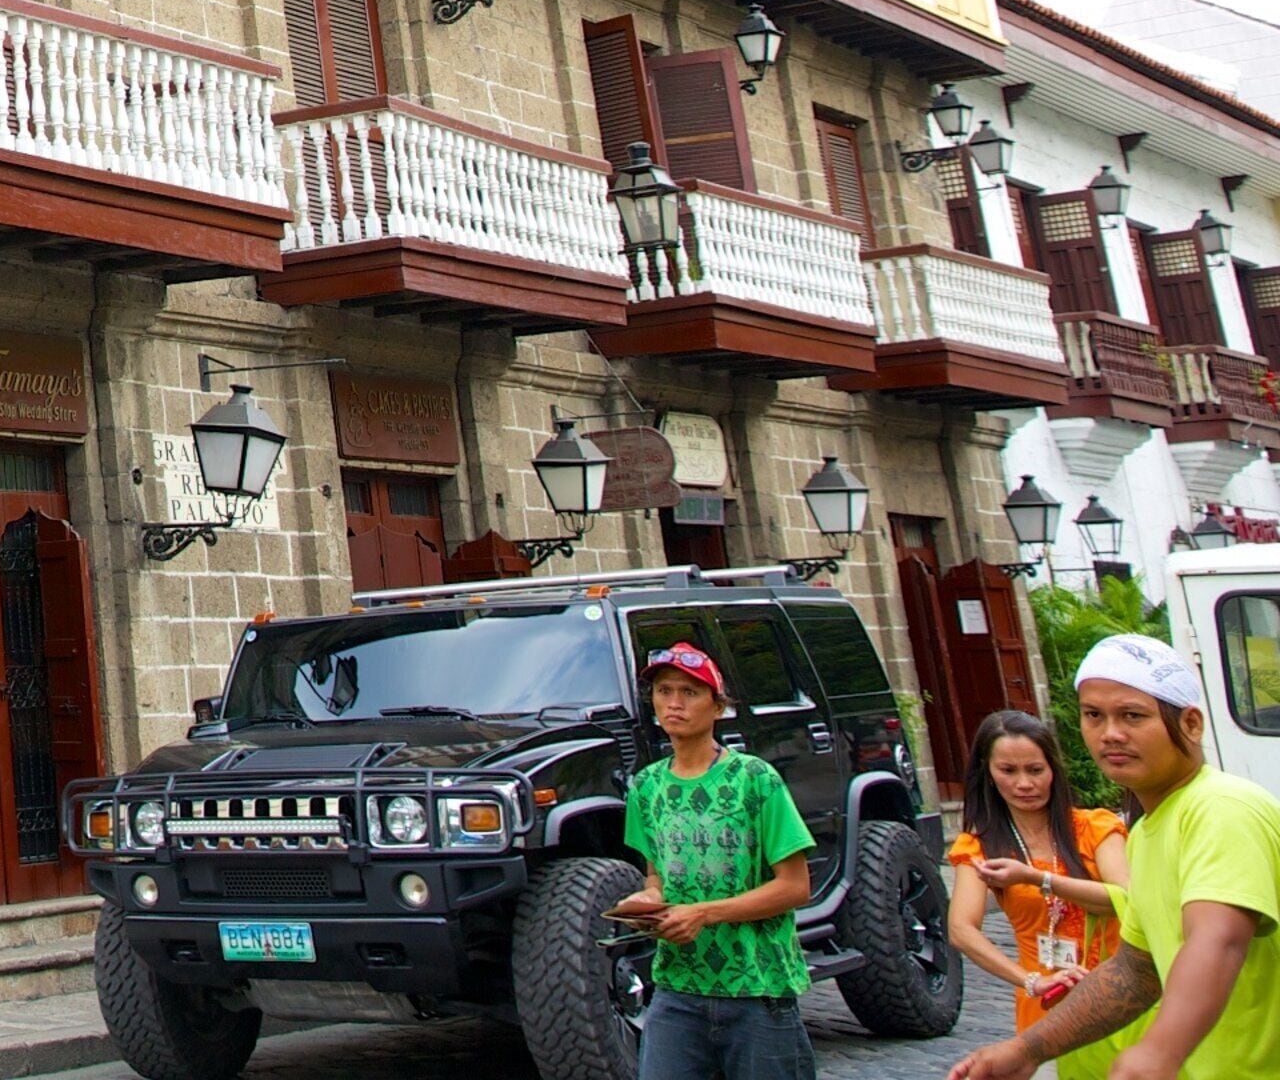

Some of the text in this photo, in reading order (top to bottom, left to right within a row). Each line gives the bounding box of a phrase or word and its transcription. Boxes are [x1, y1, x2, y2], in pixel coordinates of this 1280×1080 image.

[18, 403, 53, 422] Wedding
[368, 390, 400, 416] CAKES
[227, 928, 262, 949] BEN
